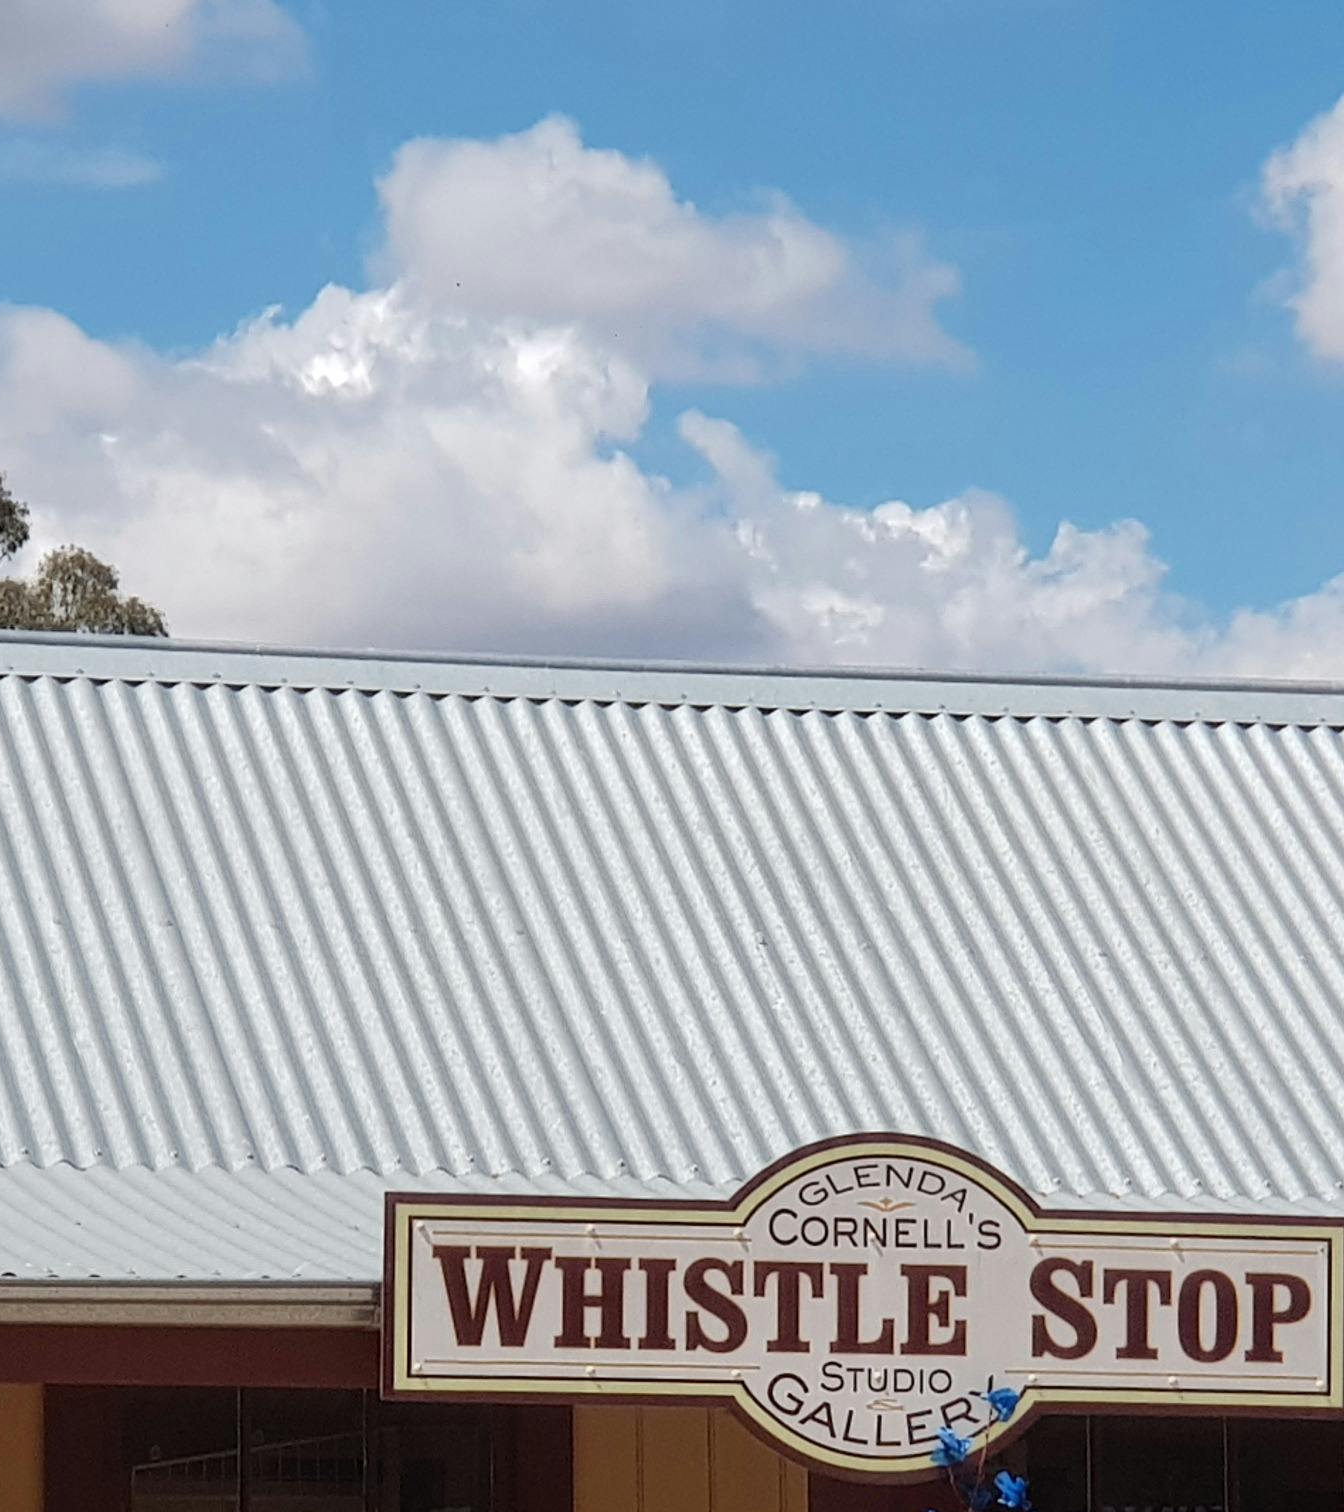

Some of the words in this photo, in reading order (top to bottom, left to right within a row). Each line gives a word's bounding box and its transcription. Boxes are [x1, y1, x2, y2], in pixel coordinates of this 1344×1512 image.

[798, 1164, 968, 1213] GLENDA
[769, 1208, 1002, 1250] CORNELL'S
[432, 1245, 968, 1357] WHISTLE
[1029, 1258, 1312, 1364] STOP
[820, 1361, 952, 1394] STUDIO
